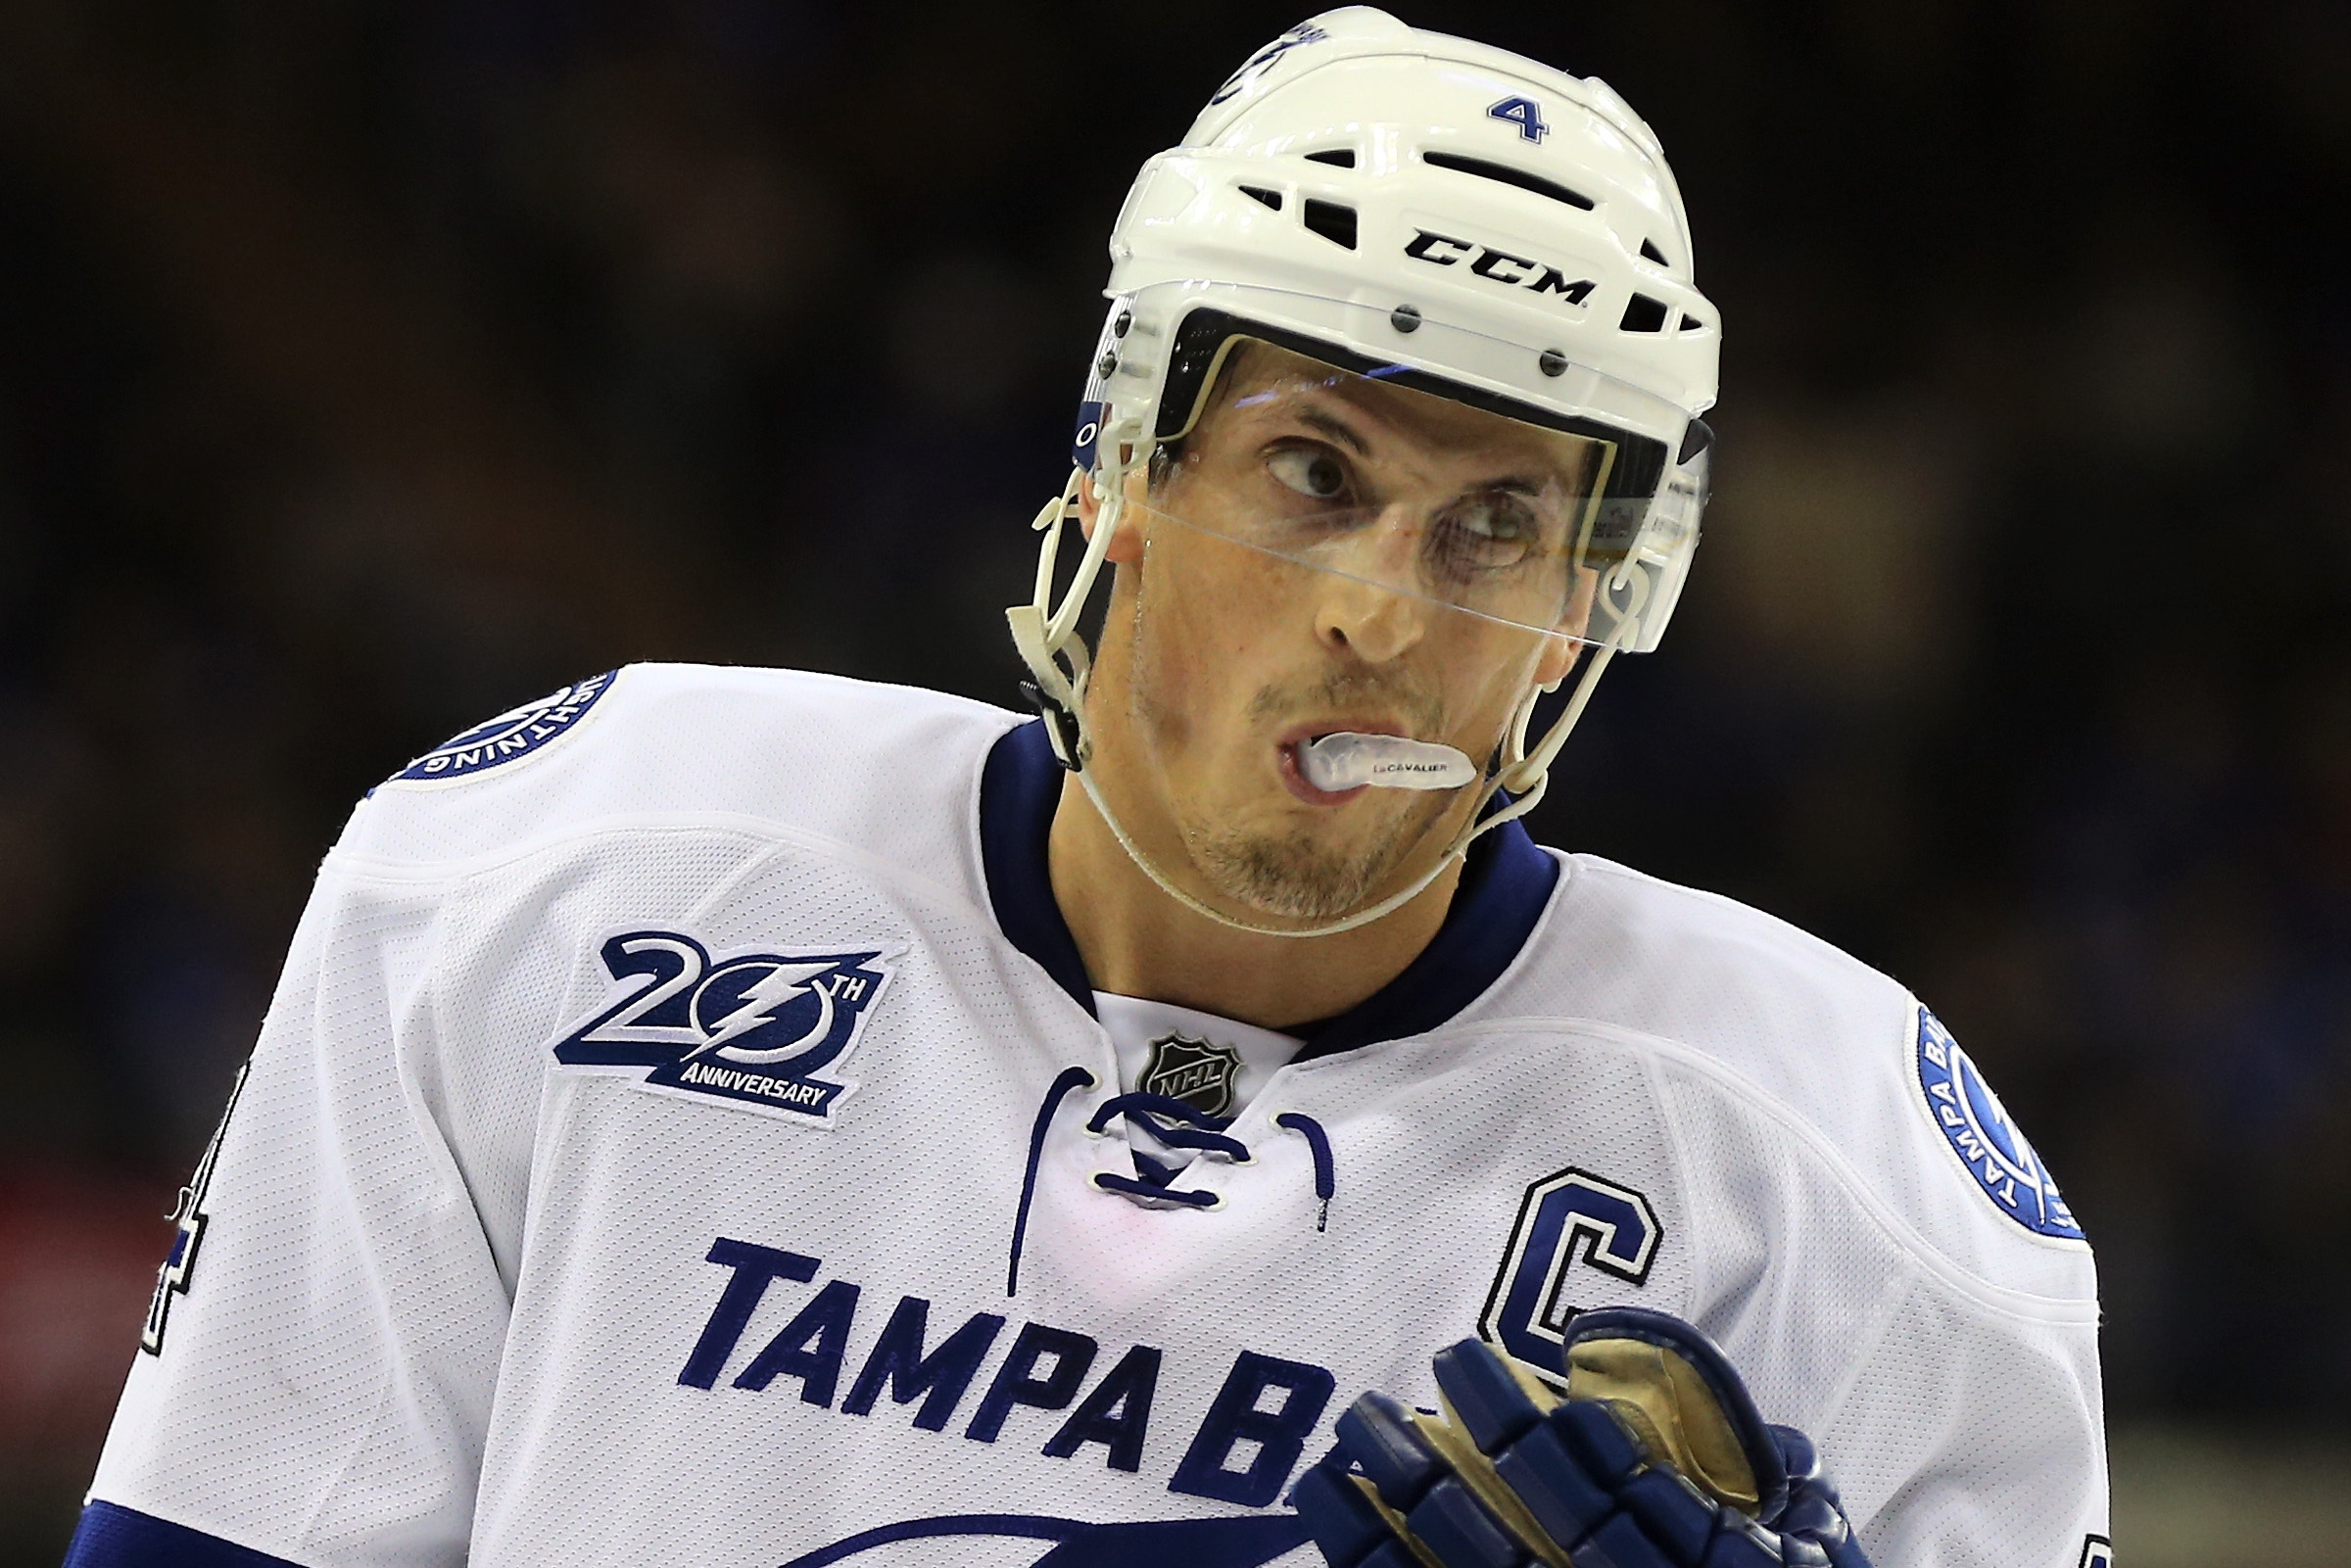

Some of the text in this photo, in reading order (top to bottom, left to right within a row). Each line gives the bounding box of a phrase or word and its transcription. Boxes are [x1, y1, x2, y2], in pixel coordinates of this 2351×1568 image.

[1487, 95, 1550, 144] 4
[1405, 225, 1598, 306] CCM
[680, 1062, 828, 1108] ANNIVERSARY
[1159, 1063, 1223, 1097] NHL
[1930, 1080, 2018, 1208] TAMPA
[1476, 1165, 1664, 1399] C
[678, 1237, 1163, 1473] TAMPA
